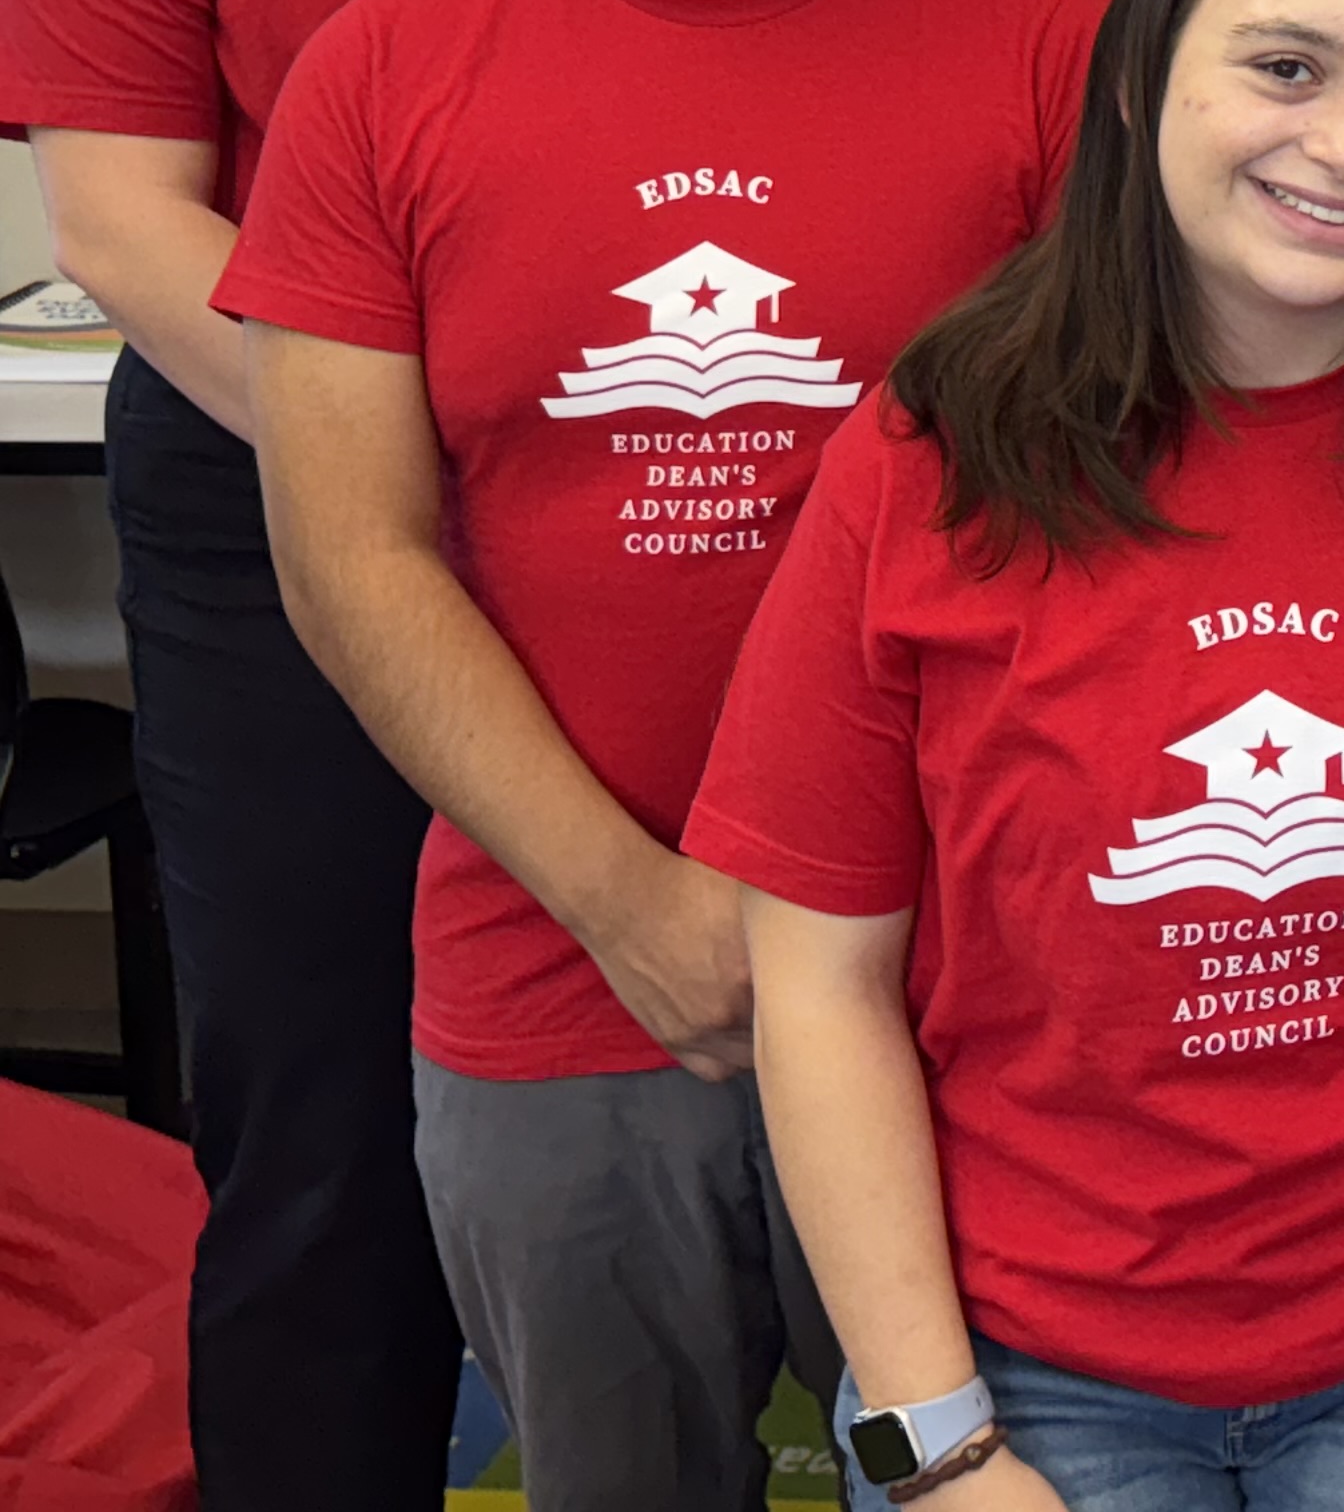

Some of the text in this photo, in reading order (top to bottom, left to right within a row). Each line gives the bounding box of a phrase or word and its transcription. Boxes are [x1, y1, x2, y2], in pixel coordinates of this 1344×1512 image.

[635, 168, 773, 210] EDSAC
[611, 430, 795, 453] EDUCATION
[646, 464, 756, 487] DEAN'S
[618, 498, 777, 520] ADVISORY
[624, 530, 766, 554] COUNCIL
[1187, 602, 1339, 650] EDSAC
[1200, 945, 1320, 982] DEAN'S
[1172, 974, 1344, 1025] ADVISORY
[1181, 1015, 1335, 1058] COUNCIL
